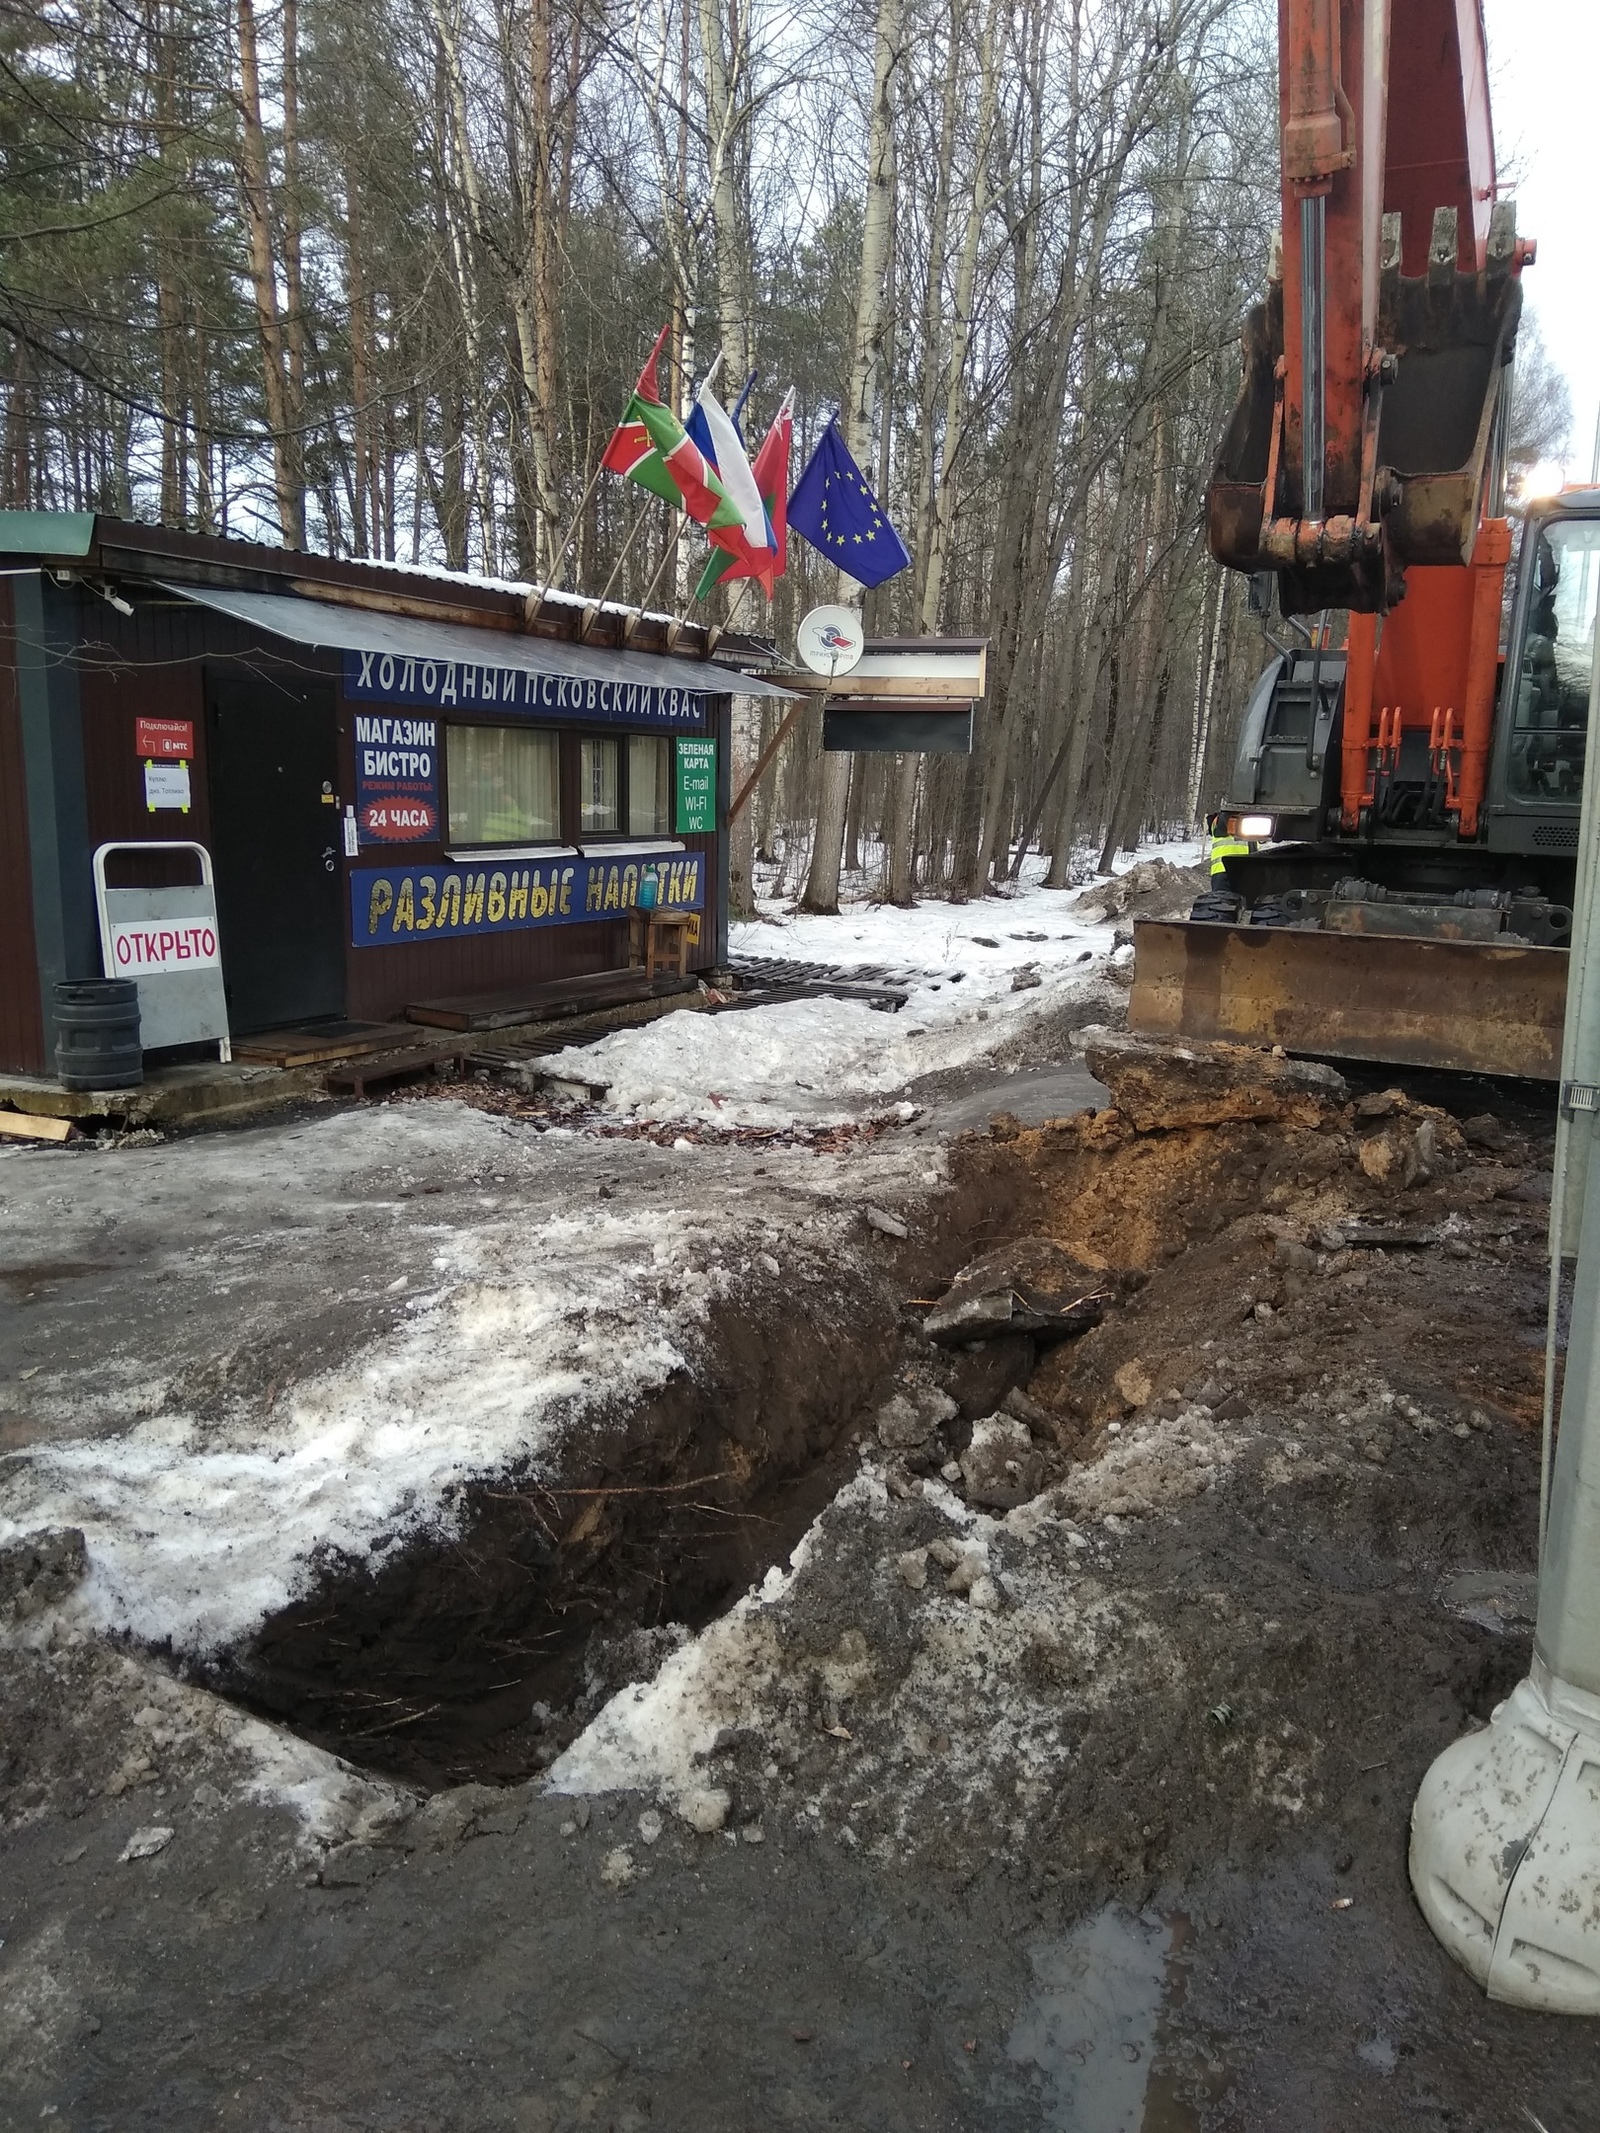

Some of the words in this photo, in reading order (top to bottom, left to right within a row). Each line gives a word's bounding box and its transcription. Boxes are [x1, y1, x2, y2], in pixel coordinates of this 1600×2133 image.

[657, 687, 701, 718] КВАС
[356, 716, 436, 747] МАГАЗИН
[678, 743, 714, 755] ЗЕЛЕНАЯ
[363, 750, 431, 777] БИСТРО
[683, 757, 709, 769] КАРТА
[362, 781, 395, 790] РЕЖИМ
[683, 776, 709, 790] E-mail
[685, 796, 707, 811] WI-FI
[369, 809, 387, 826] 24
[390, 809, 429, 826] ЧАСА
[689, 816, 703, 830] WC
[368, 867, 575, 935] РАЗЛИВНЫЕ
[586, 860, 698, 912] НАПТКИ
[116, 928, 216, 965] ОТКРЫТО
